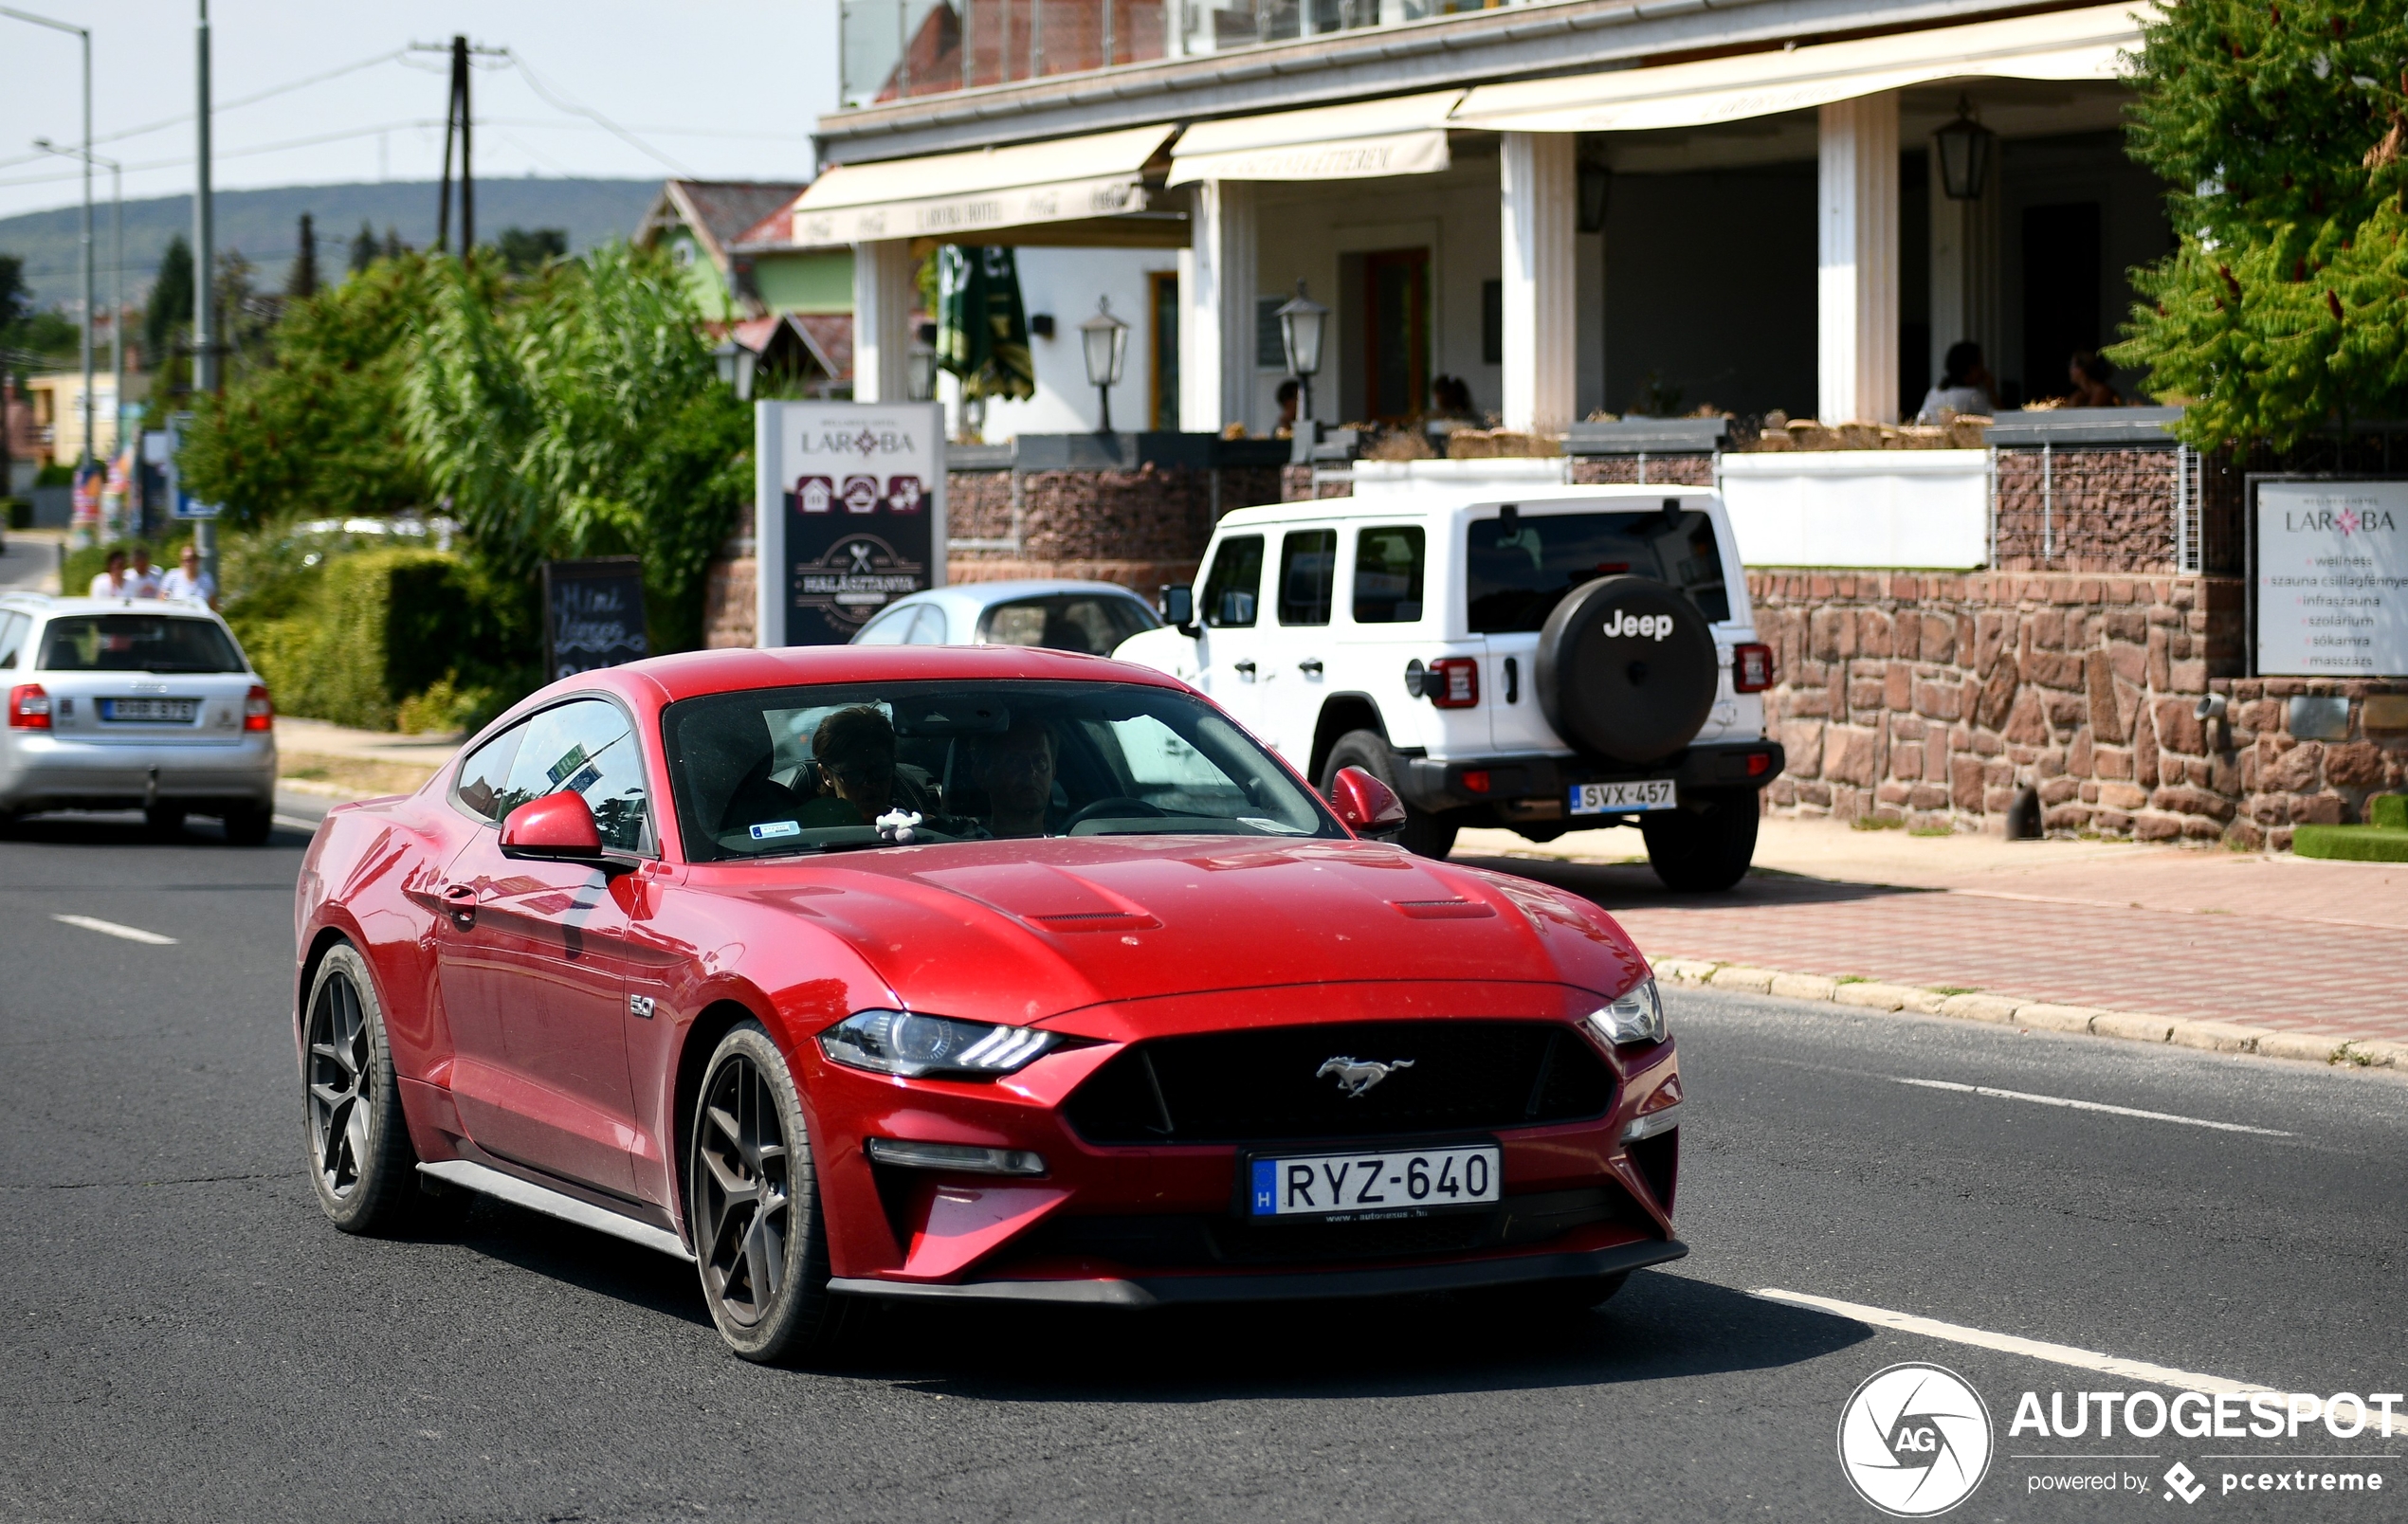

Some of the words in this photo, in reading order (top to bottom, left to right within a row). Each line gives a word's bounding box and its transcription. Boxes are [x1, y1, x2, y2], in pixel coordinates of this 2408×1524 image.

[2315, 556, 2372, 567] wellness
[2271, 577, 2317, 588] szauna
[2303, 595, 2380, 608] infraszauna
[1603, 609, 1674, 642] Jeep
[2308, 614, 2374, 627] szolárium
[2312, 633, 2370, 647] sókamra
[2309, 655, 2373, 667] masszázs
[1585, 783, 1670, 807] SVX-457
[1286, 1153, 1488, 1207] RYZ-640
[1257, 1191, 1269, 1207] H
